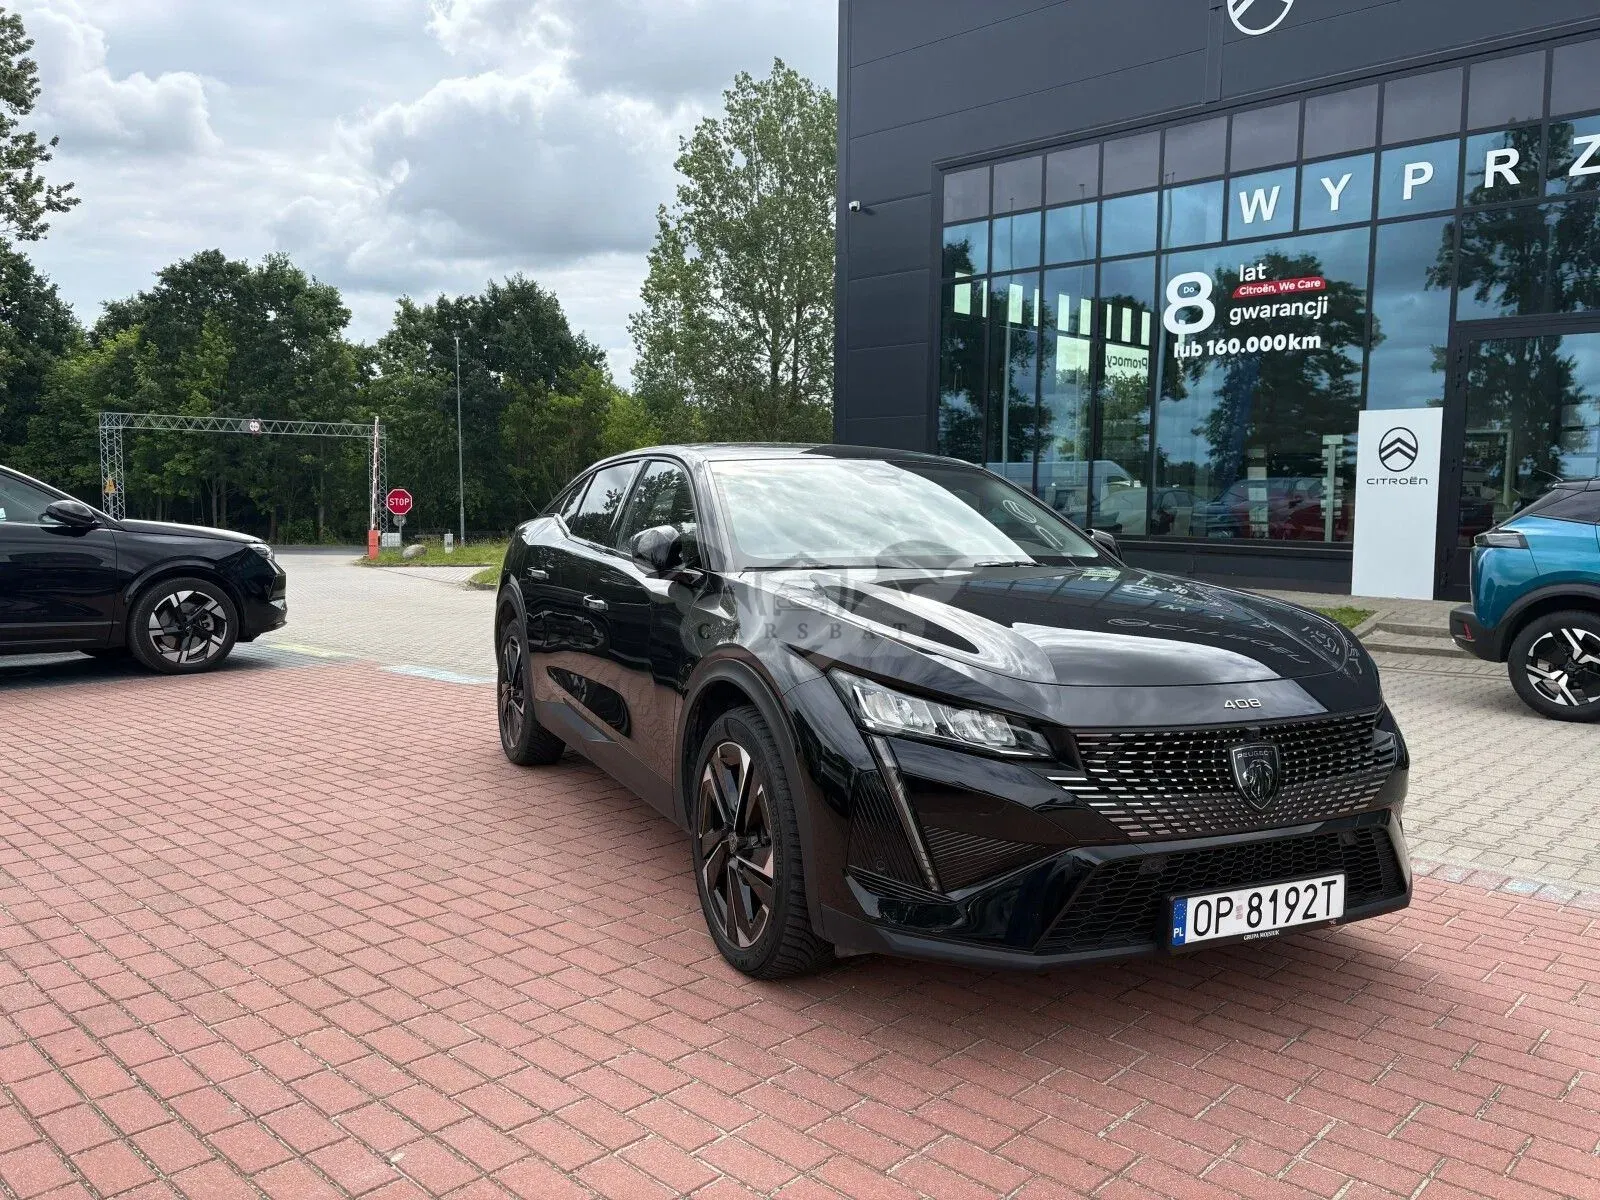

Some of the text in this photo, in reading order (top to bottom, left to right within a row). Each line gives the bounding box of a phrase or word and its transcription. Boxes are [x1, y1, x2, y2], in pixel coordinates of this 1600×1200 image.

[1239, 263, 1267, 282] lat
[1183, 286, 1195, 294] Do
[1239, 279, 1321, 296] Citroën, We Care
[1163, 271, 1216, 335] 8
[1229, 296, 1329, 326] gwarancji
[1174, 341, 1203, 358] lub
[1366, 476, 1428, 485] CITROËN
[389, 498, 410, 506] STOP
[1225, 698, 1262, 709] 408
[1237, 750, 1273, 759] PEUGEOT
[1193, 880, 1337, 937] OP 8192T
[1173, 928, 1184, 938] PL
